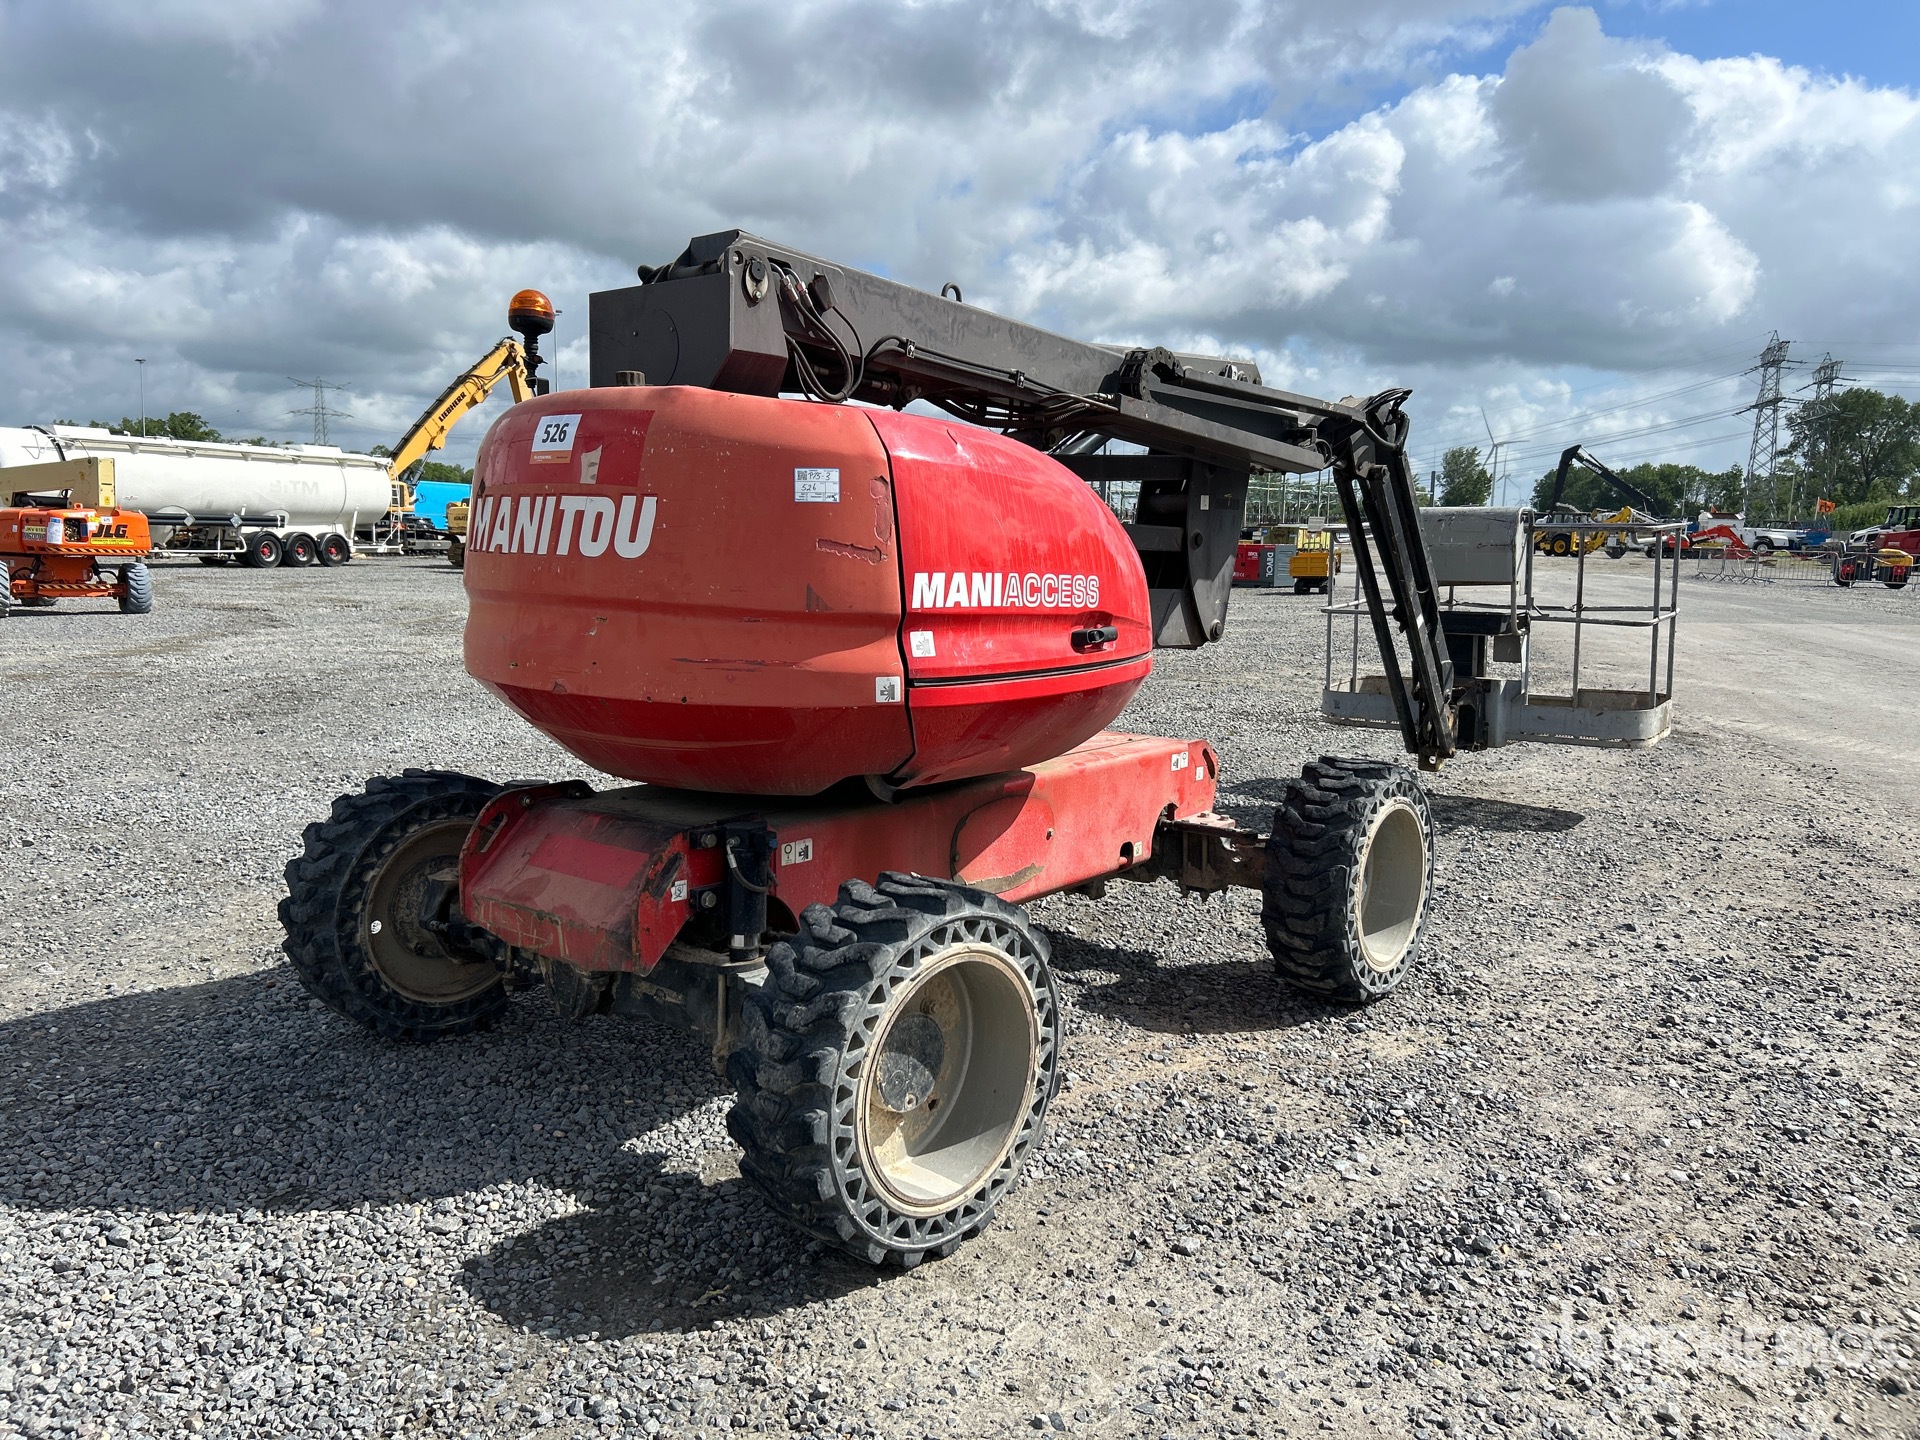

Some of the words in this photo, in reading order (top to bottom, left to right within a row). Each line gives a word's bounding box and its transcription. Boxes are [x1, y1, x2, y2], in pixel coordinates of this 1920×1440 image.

[438, 391, 467, 422] LIEBHERR
[541, 422, 570, 444] 526
[801, 483, 817, 492] 526
[92, 524, 128, 538] JLG
[470, 494, 659, 559] MANITOU
[911, 572, 1100, 609] MANIACCESS
